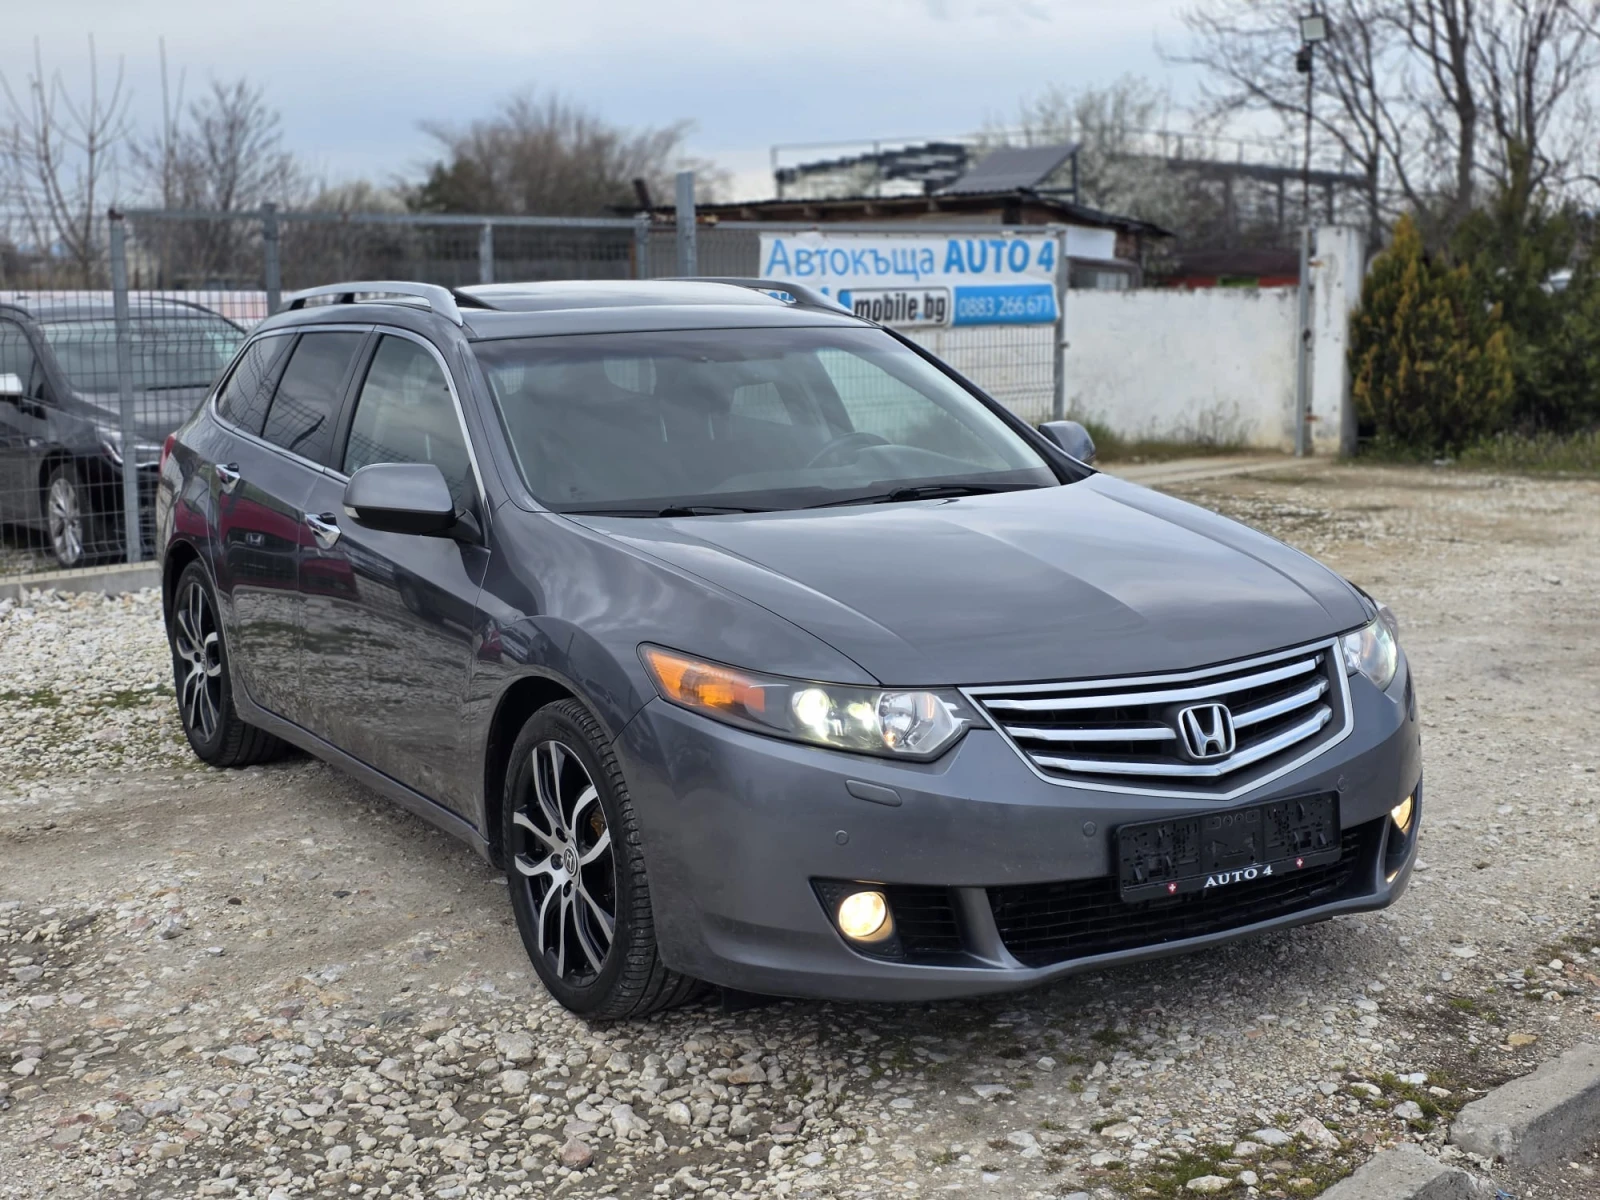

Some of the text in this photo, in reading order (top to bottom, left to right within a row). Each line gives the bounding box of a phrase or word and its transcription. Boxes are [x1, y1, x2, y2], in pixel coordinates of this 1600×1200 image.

[765, 239, 1055, 281] Автокъща AUTO 4
[854, 292, 946, 322] mobile.bg
[959, 294, 1052, 317] 0883 266 677
[1203, 864, 1274, 888] AUTO 4
